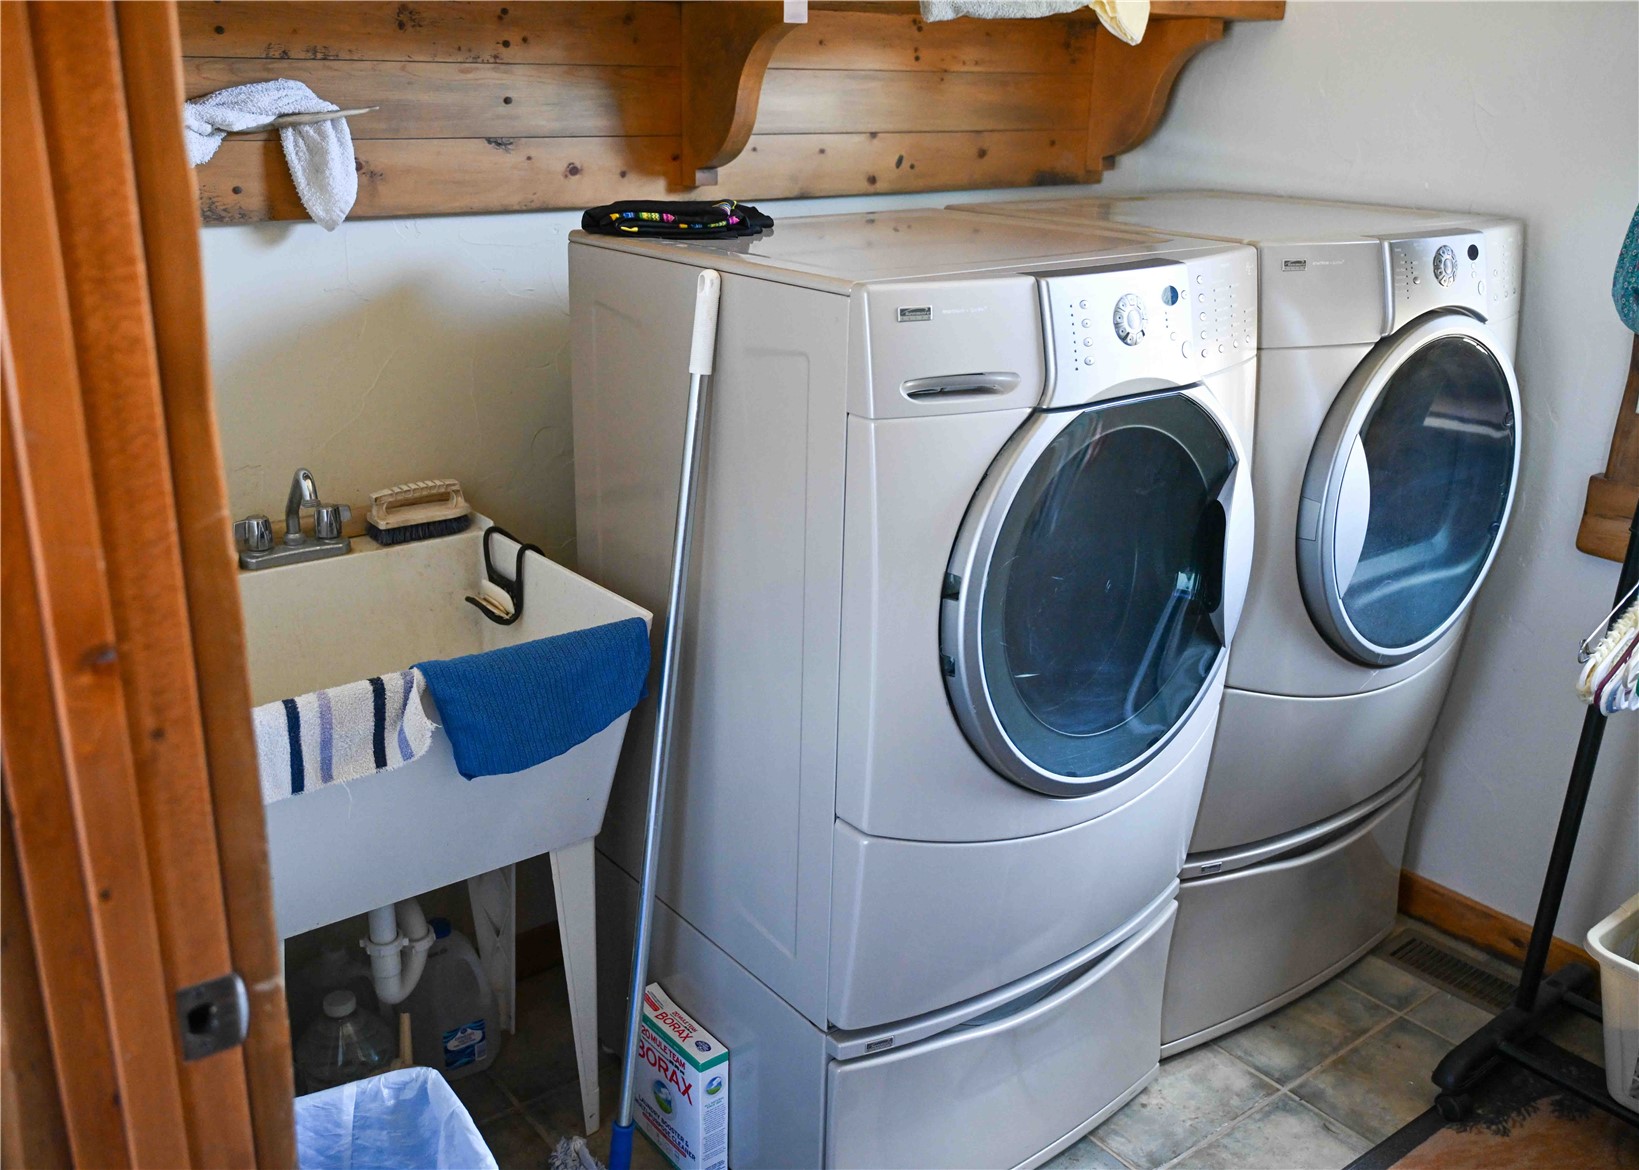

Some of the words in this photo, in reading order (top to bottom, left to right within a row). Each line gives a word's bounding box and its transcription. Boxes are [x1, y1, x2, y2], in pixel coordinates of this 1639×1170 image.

[641, 1024, 651, 1039] 20
[650, 1033, 668, 1055] MULE
[667, 1049, 686, 1071] TEAM
[655, 1011, 693, 1043] BORAX
[638, 1039, 693, 1106] BORAX
[638, 1094, 661, 1119] LAUNDRY
[661, 1117, 685, 1142] BOOSTER
[671, 1135, 696, 1162] CLEANER
